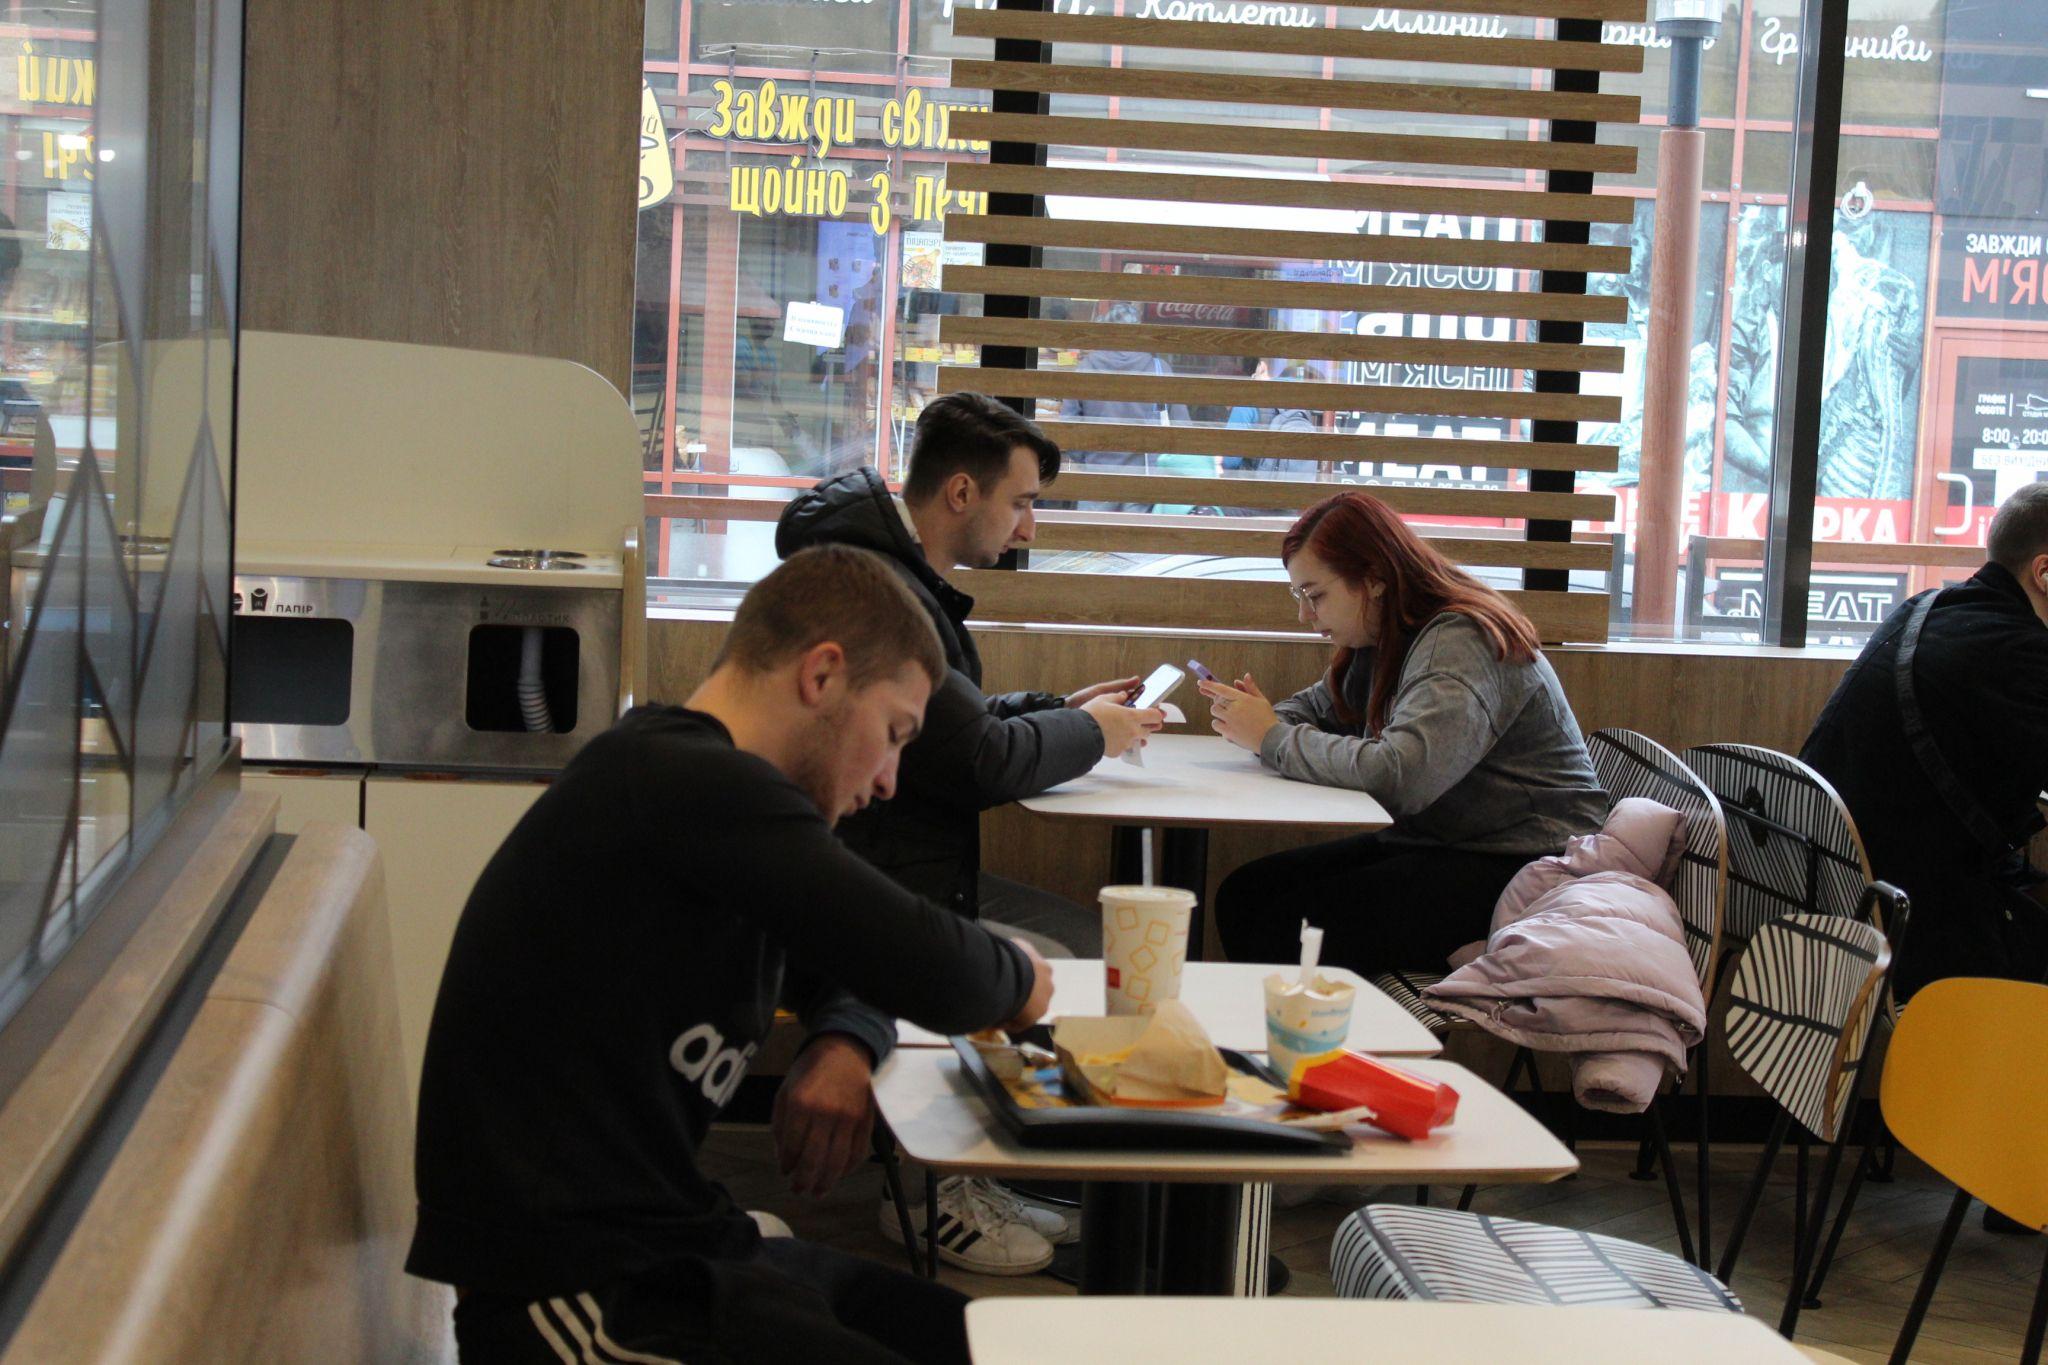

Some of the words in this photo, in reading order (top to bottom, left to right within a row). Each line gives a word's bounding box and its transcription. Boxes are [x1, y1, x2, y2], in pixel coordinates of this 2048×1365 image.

[709, 79, 856, 159] Завжди
[729, 155, 849, 217] щойно
[1965, 233, 2042, 257] ЗАВЖДИ
[1982, 427, 2010, 443] 8:00
[2021, 429, 2048, 445] 20:0
[1727, 493, 1897, 543] КРКА
[276, 604, 313, 615] ПАПІР
